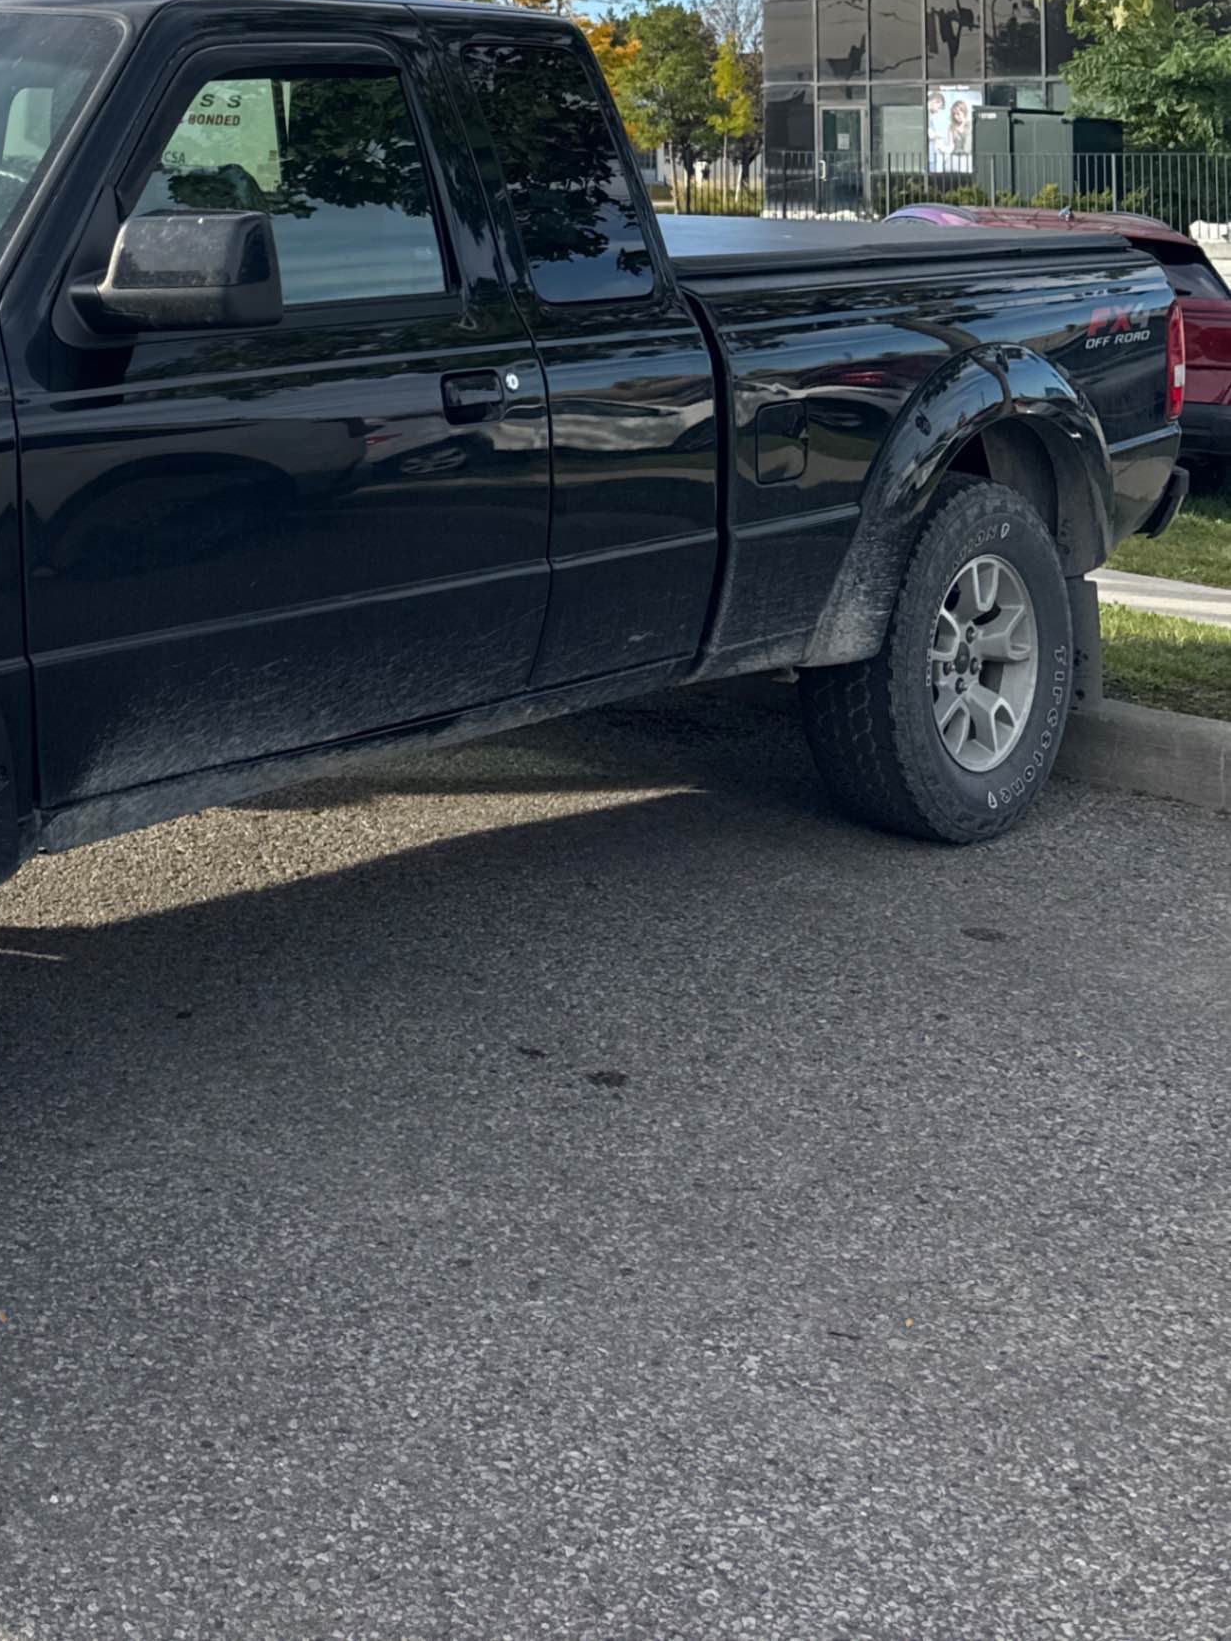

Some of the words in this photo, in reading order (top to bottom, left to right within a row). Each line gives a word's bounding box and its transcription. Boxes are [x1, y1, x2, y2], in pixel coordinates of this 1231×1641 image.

[187, 113, 241, 127] BONDED
[1087, 302, 1150, 337] FX4
[1085, 336, 1111, 350] OFF
[1114, 330, 1151, 345] ROAD
